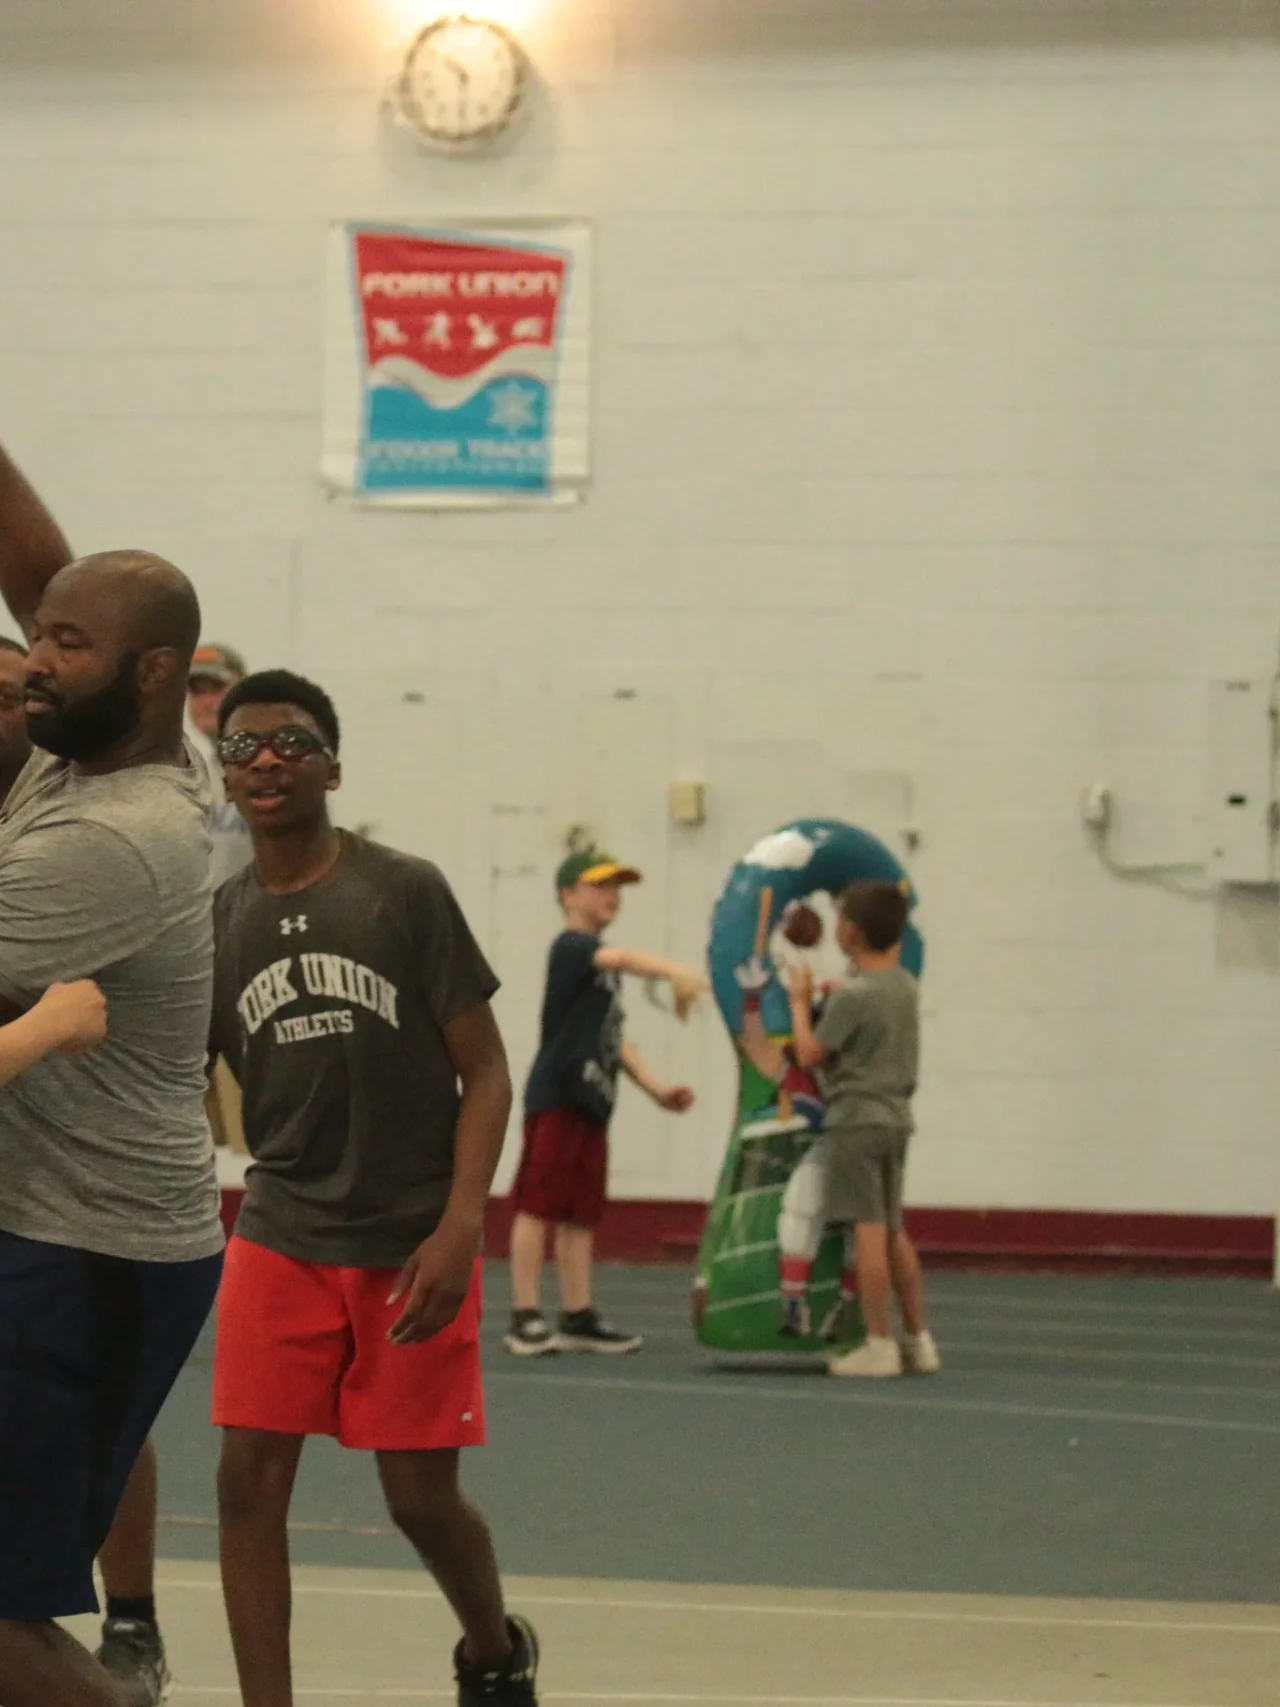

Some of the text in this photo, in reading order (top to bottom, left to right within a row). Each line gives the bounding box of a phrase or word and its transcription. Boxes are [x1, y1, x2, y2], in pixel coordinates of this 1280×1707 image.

[458, 271, 559, 299] UNION
[236, 952, 400, 1034] ORK UNION
